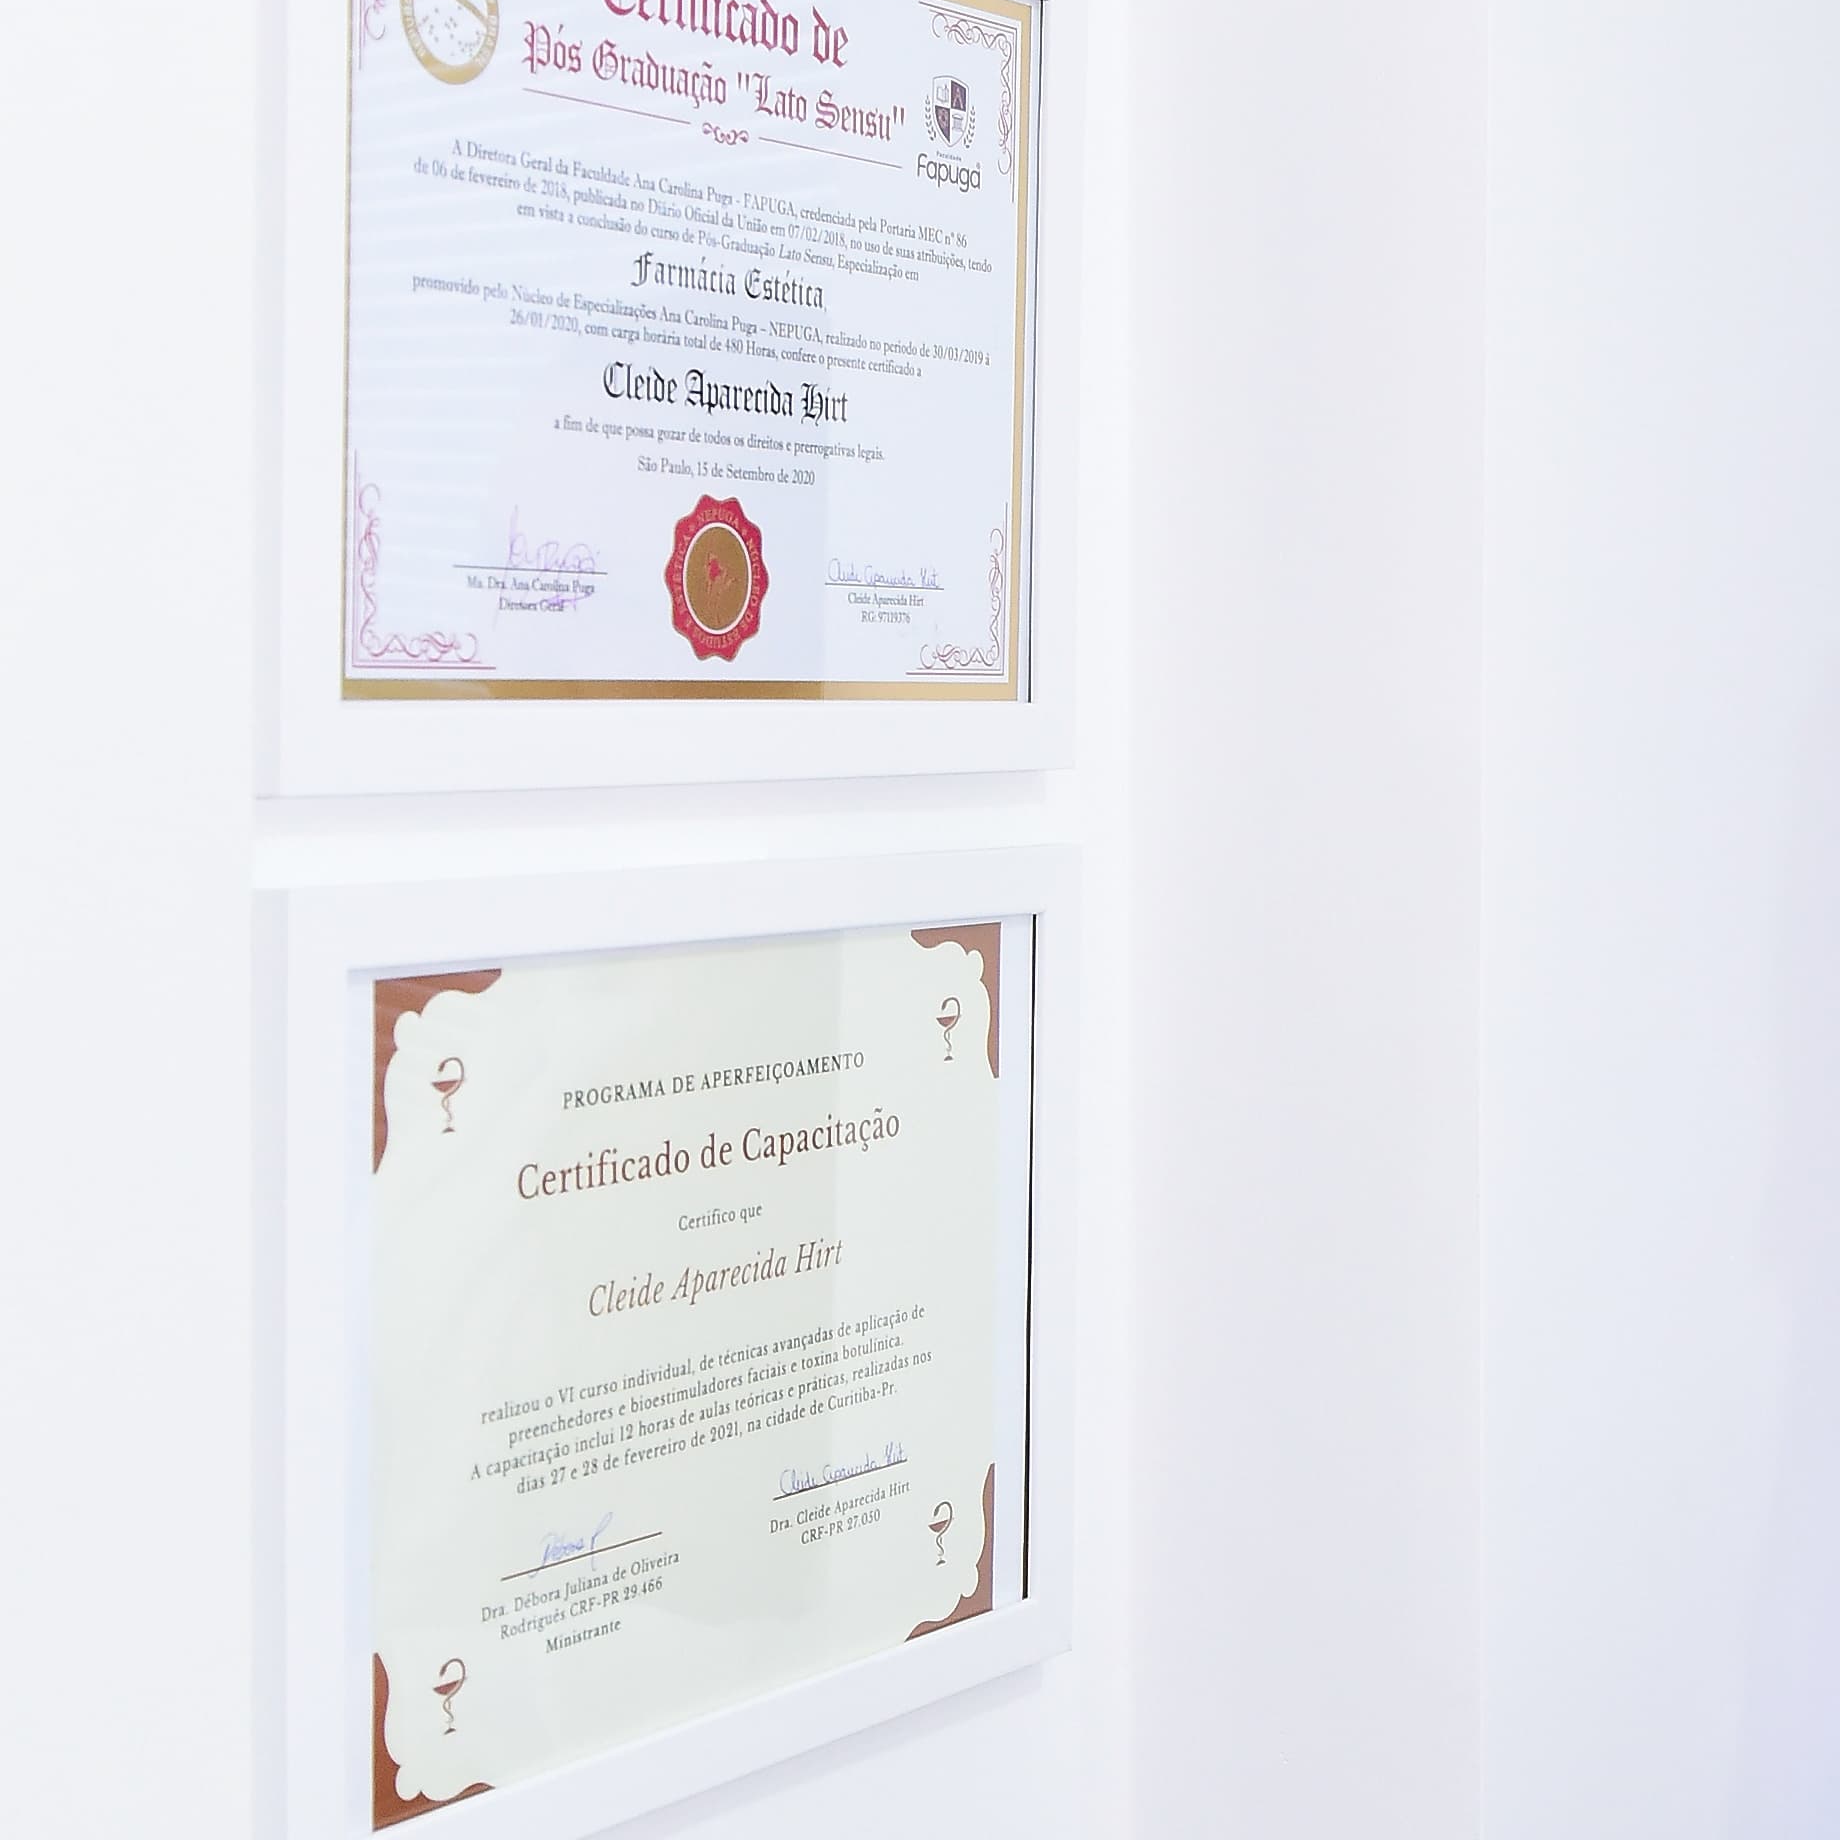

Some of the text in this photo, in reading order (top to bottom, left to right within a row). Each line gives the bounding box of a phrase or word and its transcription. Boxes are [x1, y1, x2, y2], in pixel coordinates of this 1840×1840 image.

[522, 21, 582, 74] Pós
[592, 39, 726, 108] Graduação
[812, 6, 848, 68] de
[916, 152, 980, 193] Fapuga
[630, 251, 736, 295] Farmácia
[603, 361, 847, 426] Cleide Aparecida Hirt
[637, 455, 815, 486] São Paulo, 15 de Setembro de 2020
[563, 1051, 864, 1109] PROGRAMA DE APERFEIÇOAMENTO
[518, 1108, 899, 1199] Certificado de Capacitação
[678, 1205, 762, 1231] Certifico que
[589, 1238, 842, 1316] Cleide Aparecida Hirt
[481, 1399, 539, 1424] realizou
[544, 1396, 553, 1408] o
[558, 1386, 574, 1403] VI
[579, 1380, 617, 1400] curso
[699, 1354, 714, 1371] de
[718, 1344, 768, 1366] técnicas
[772, 1326, 833, 1354] avançadas
[836, 1321, 851, 1337] de
[854, 1309, 908, 1337] aplicação
[911, 1303, 925, 1320] de
[471, 1464, 481, 1480] A
[486, 1442, 569, 1476] capacitação
[575, 1431, 614, 1453] inclui
[620, 1423, 633, 1442] 12
[638, 1416, 675, 1437] horas
[678, 1408, 694, 1426] de
[699, 1400, 730, 1421] aulas
[734, 1388, 784, 1411] teóricas
[787, 1386, 794, 1398] e
[852, 1354, 909, 1381] realizadas
[912, 1351, 931, 1366] nos
[508, 1407, 613, 1449] preenchedores
[618, 1404, 626, 1416] e
[630, 1375, 743, 1413] bioestimuladores
[747, 1360, 786, 1384] faciais
[790, 1361, 797, 1373] e
[801, 1350, 839, 1370] toxina
[516, 1476, 545, 1494] dias
[550, 1466, 566, 1485] 27
[570, 1468, 577, 1480] e
[582, 1457, 598, 1477] 28
[602, 1453, 619, 1471] de
[624, 1437, 686, 1466] fevereiro
[690, 1430, 705, 1448] de
[709, 1420, 742, 1443] 2021,
[747, 1419, 761, 1433] na
[765, 1403, 806, 1428] cidade
[809, 1398, 824, 1416] de
[796, 1503, 831, 1525] Cleide
[834, 1487, 885, 1515] Aparecida
[889, 1481, 909, 1497] Hirt
[800, 1508, 880, 1544] CRF-PR 27.050
[514, 1588, 561, 1612] Débora
[563, 1574, 608, 1600] Juliana
[612, 1565, 627, 1582] de
[630, 1551, 679, 1576] Oliveira
[569, 1590, 619, 1617] CRF-PR
[546, 1620, 621, 1653] Ministrante
